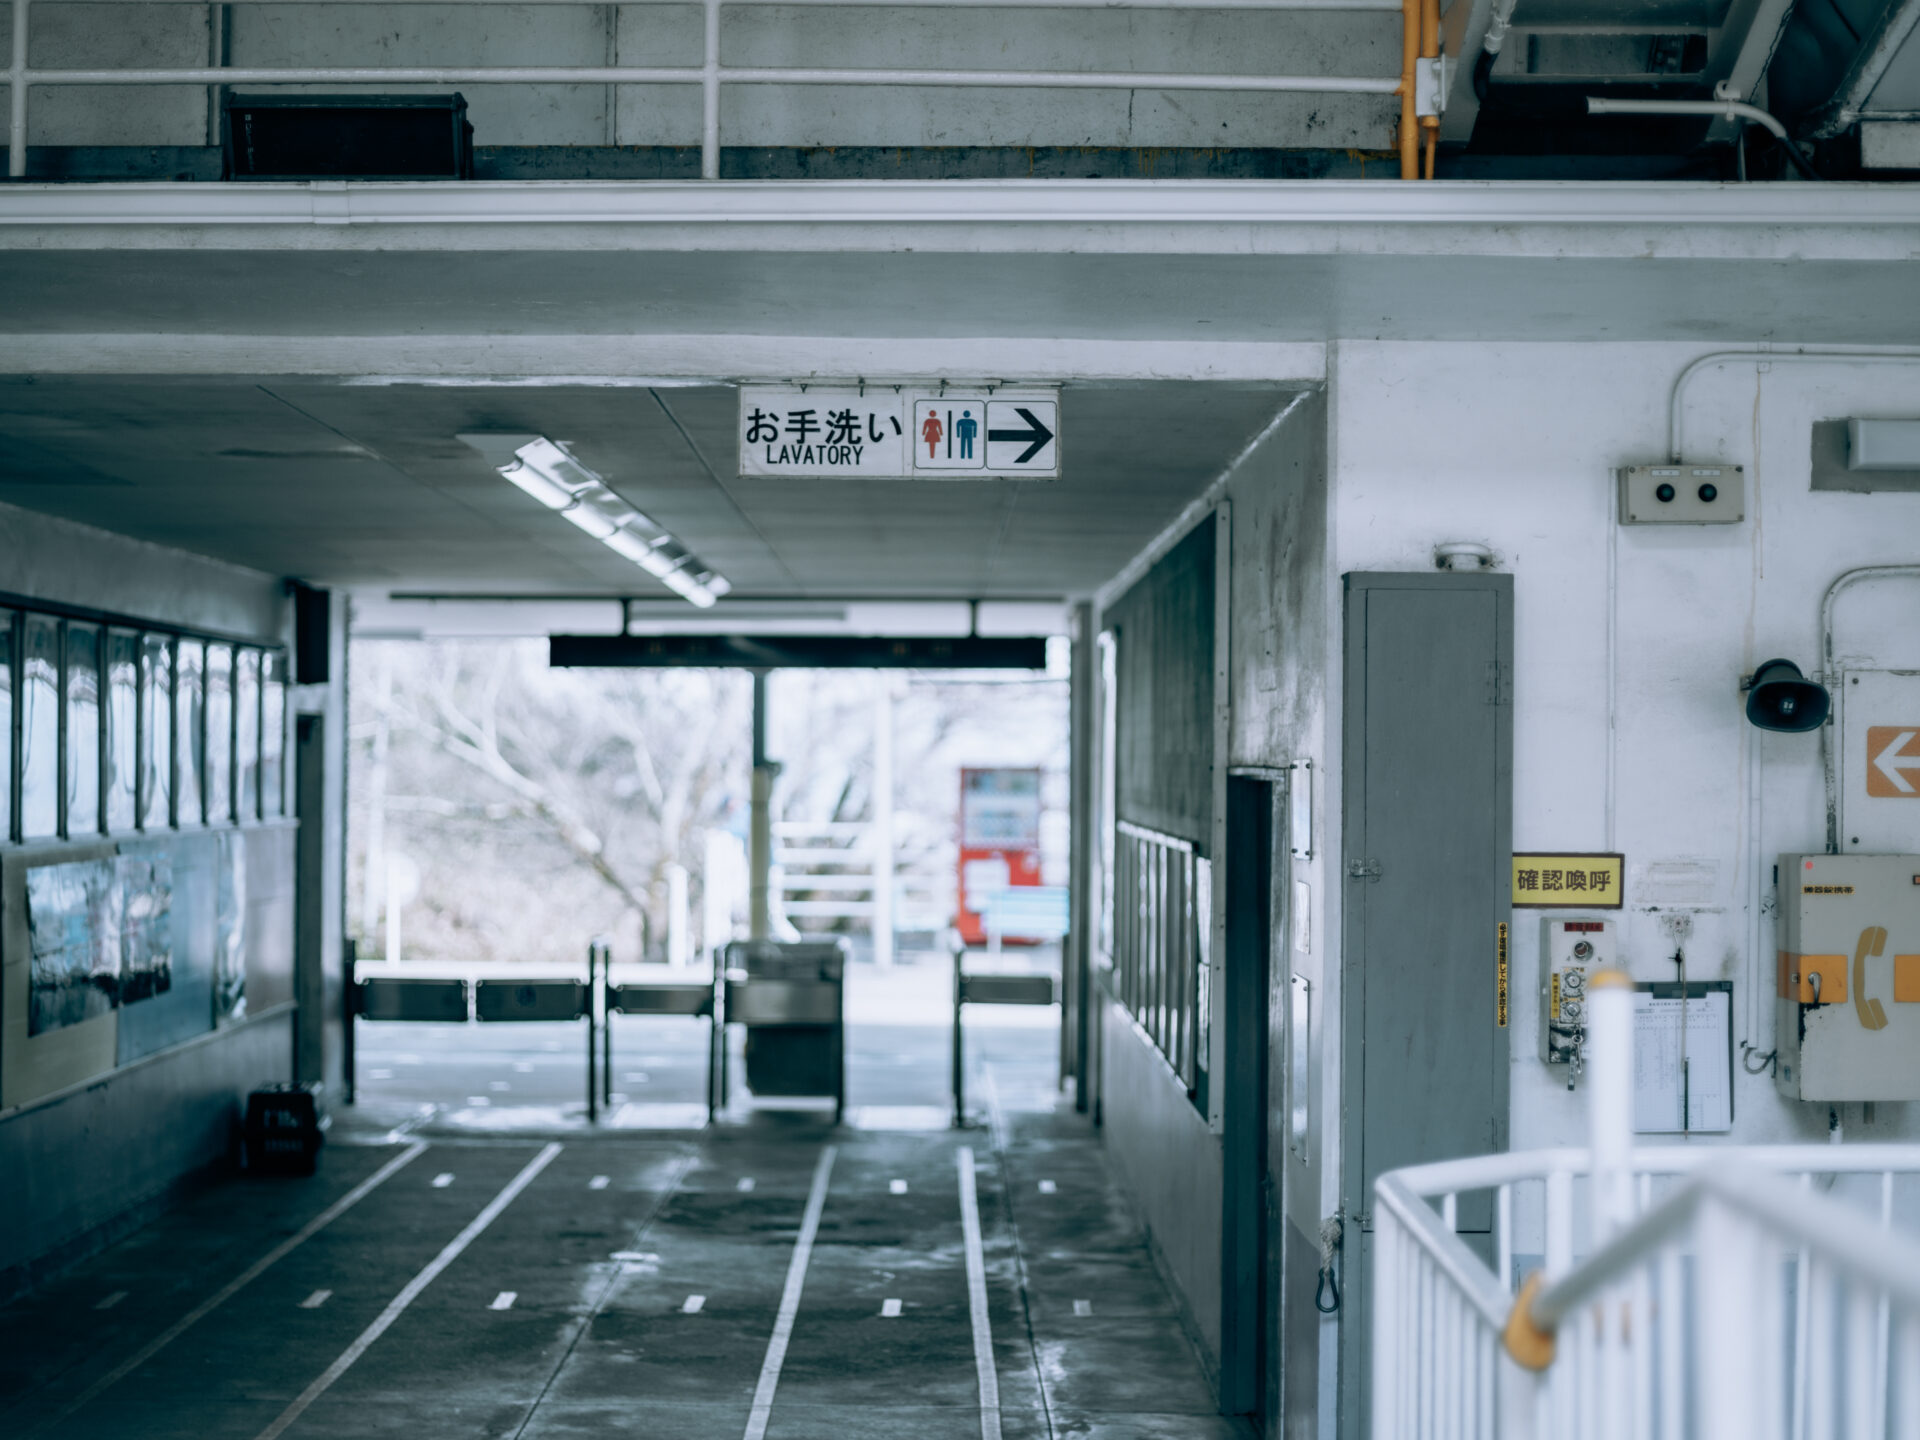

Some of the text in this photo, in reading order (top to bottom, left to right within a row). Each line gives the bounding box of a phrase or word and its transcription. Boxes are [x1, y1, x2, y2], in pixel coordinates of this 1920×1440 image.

[746, 408, 903, 445] お手洗い
[766, 445, 864, 465] LAVATORY
[1517, 869, 1612, 892] 確認喚呼
